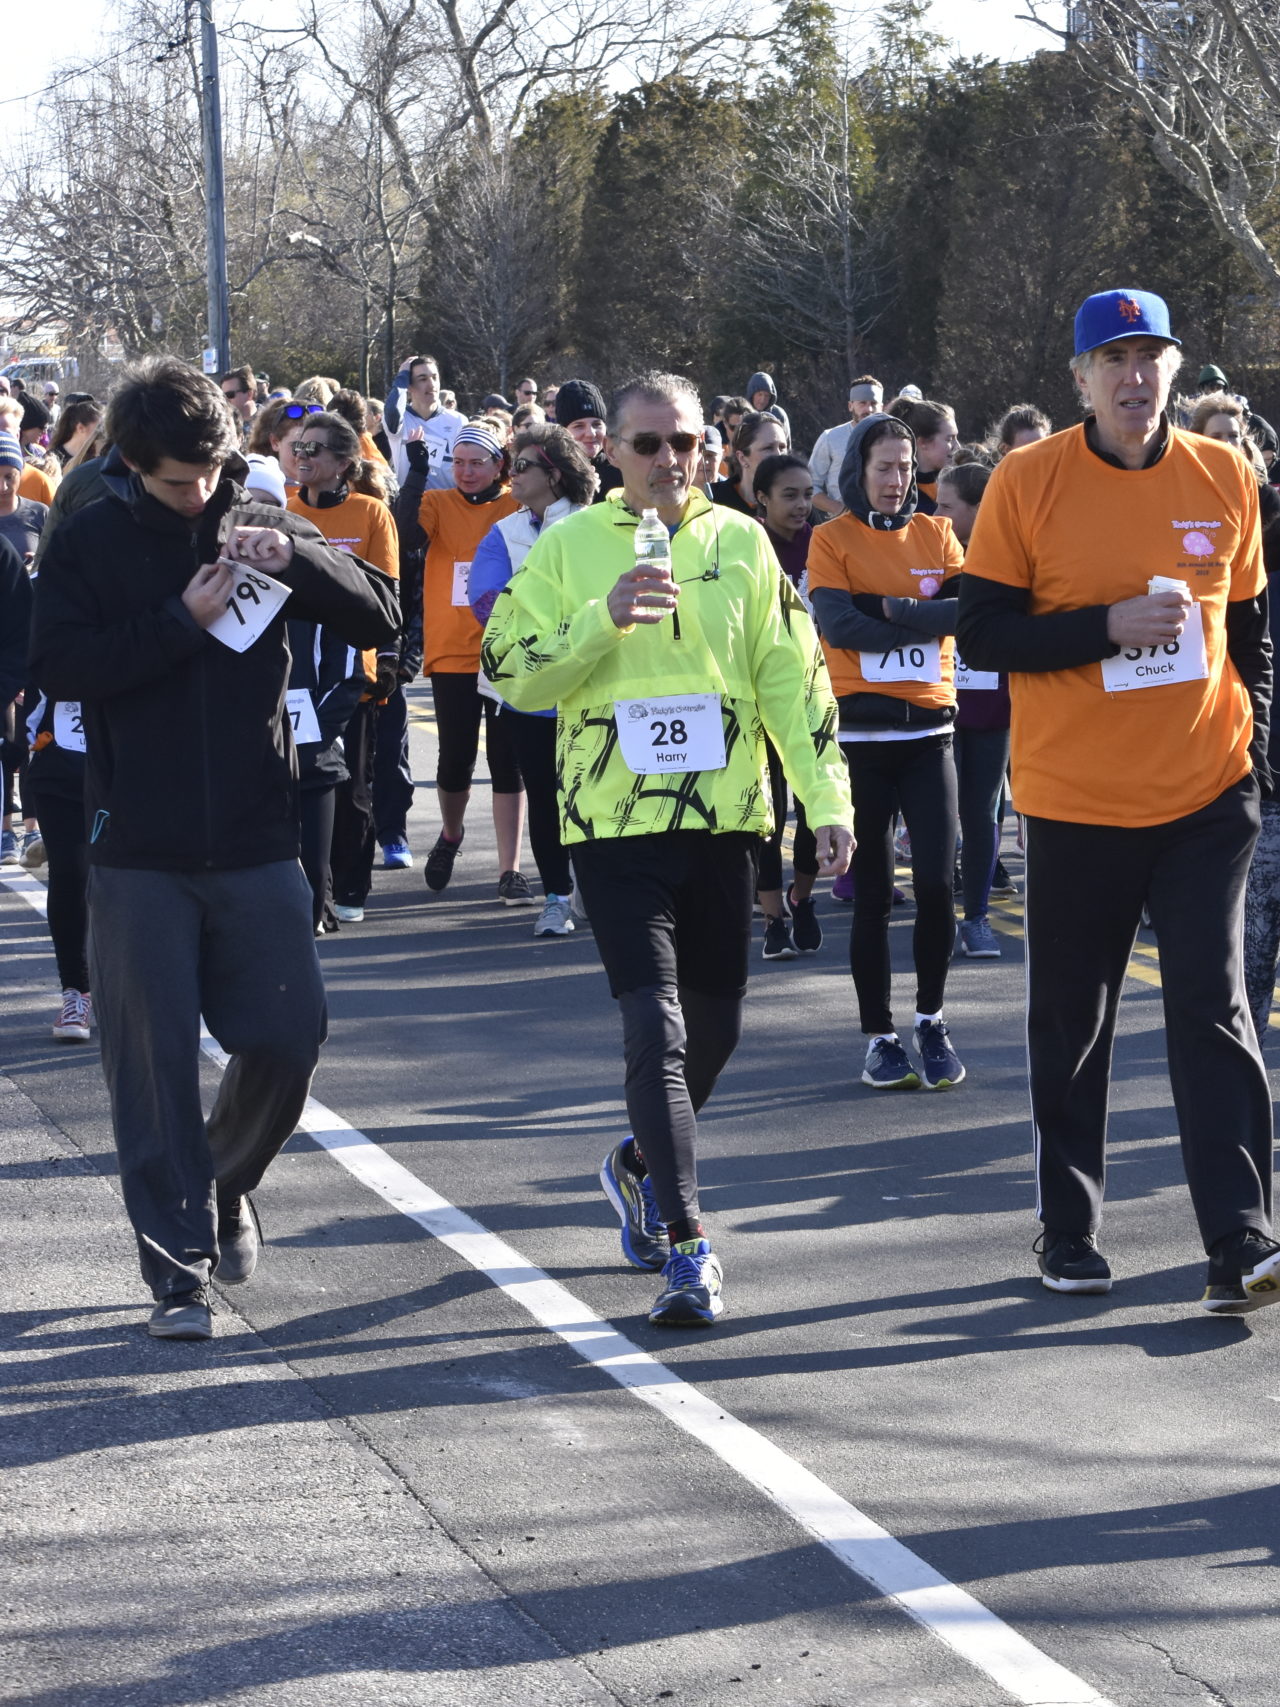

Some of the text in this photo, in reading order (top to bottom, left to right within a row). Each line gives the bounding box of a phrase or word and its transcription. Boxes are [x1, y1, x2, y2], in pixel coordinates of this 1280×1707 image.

[1135, 662, 1175, 677] Chuck
[650, 720, 688, 746] 28
[656, 752, 688, 763] Harry
